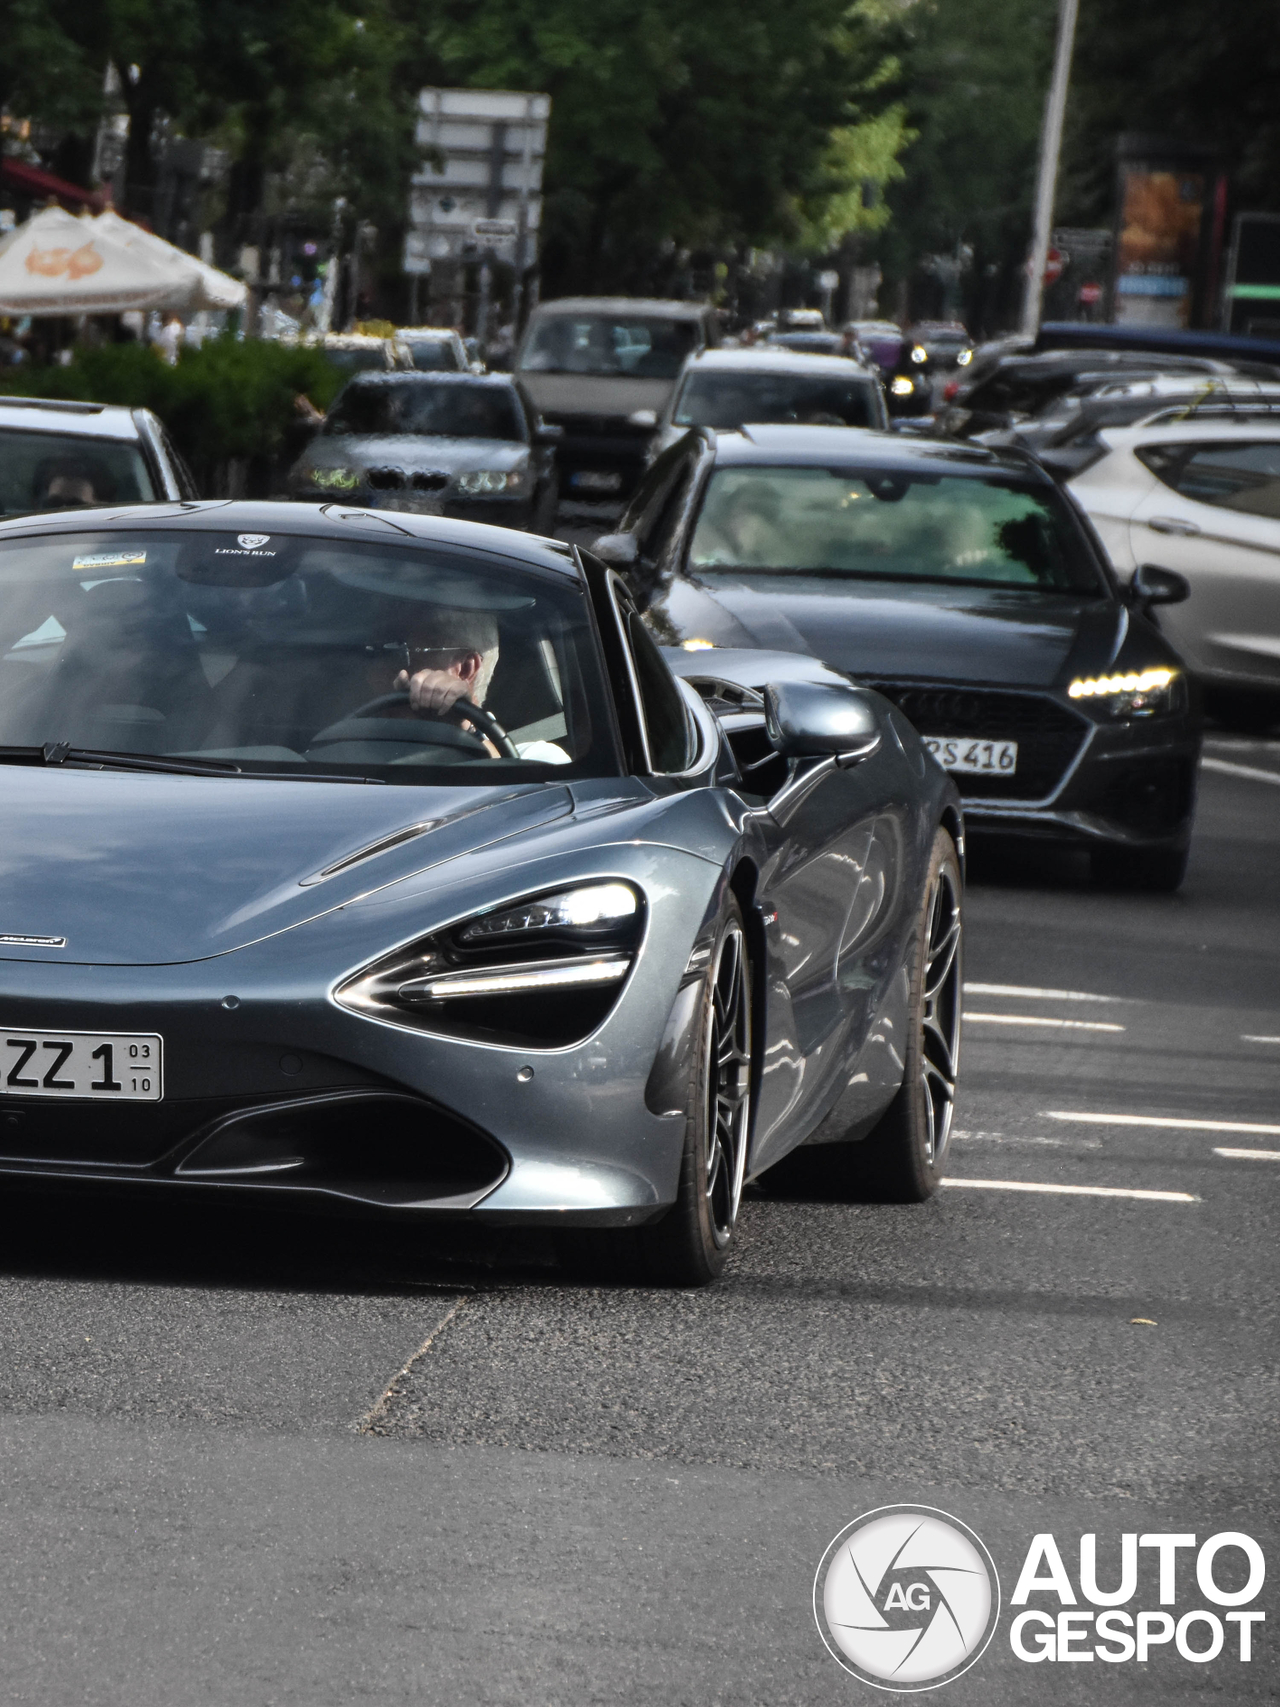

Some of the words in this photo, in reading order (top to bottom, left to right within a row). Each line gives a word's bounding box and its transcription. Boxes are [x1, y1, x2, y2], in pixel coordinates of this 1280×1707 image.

[963, 743, 1014, 770] 416
[6, 1038, 75, 1090] ZZ
[91, 1043, 122, 1091] 1
[129, 1044, 151, 1058] 03
[131, 1078, 151, 1092] 10
